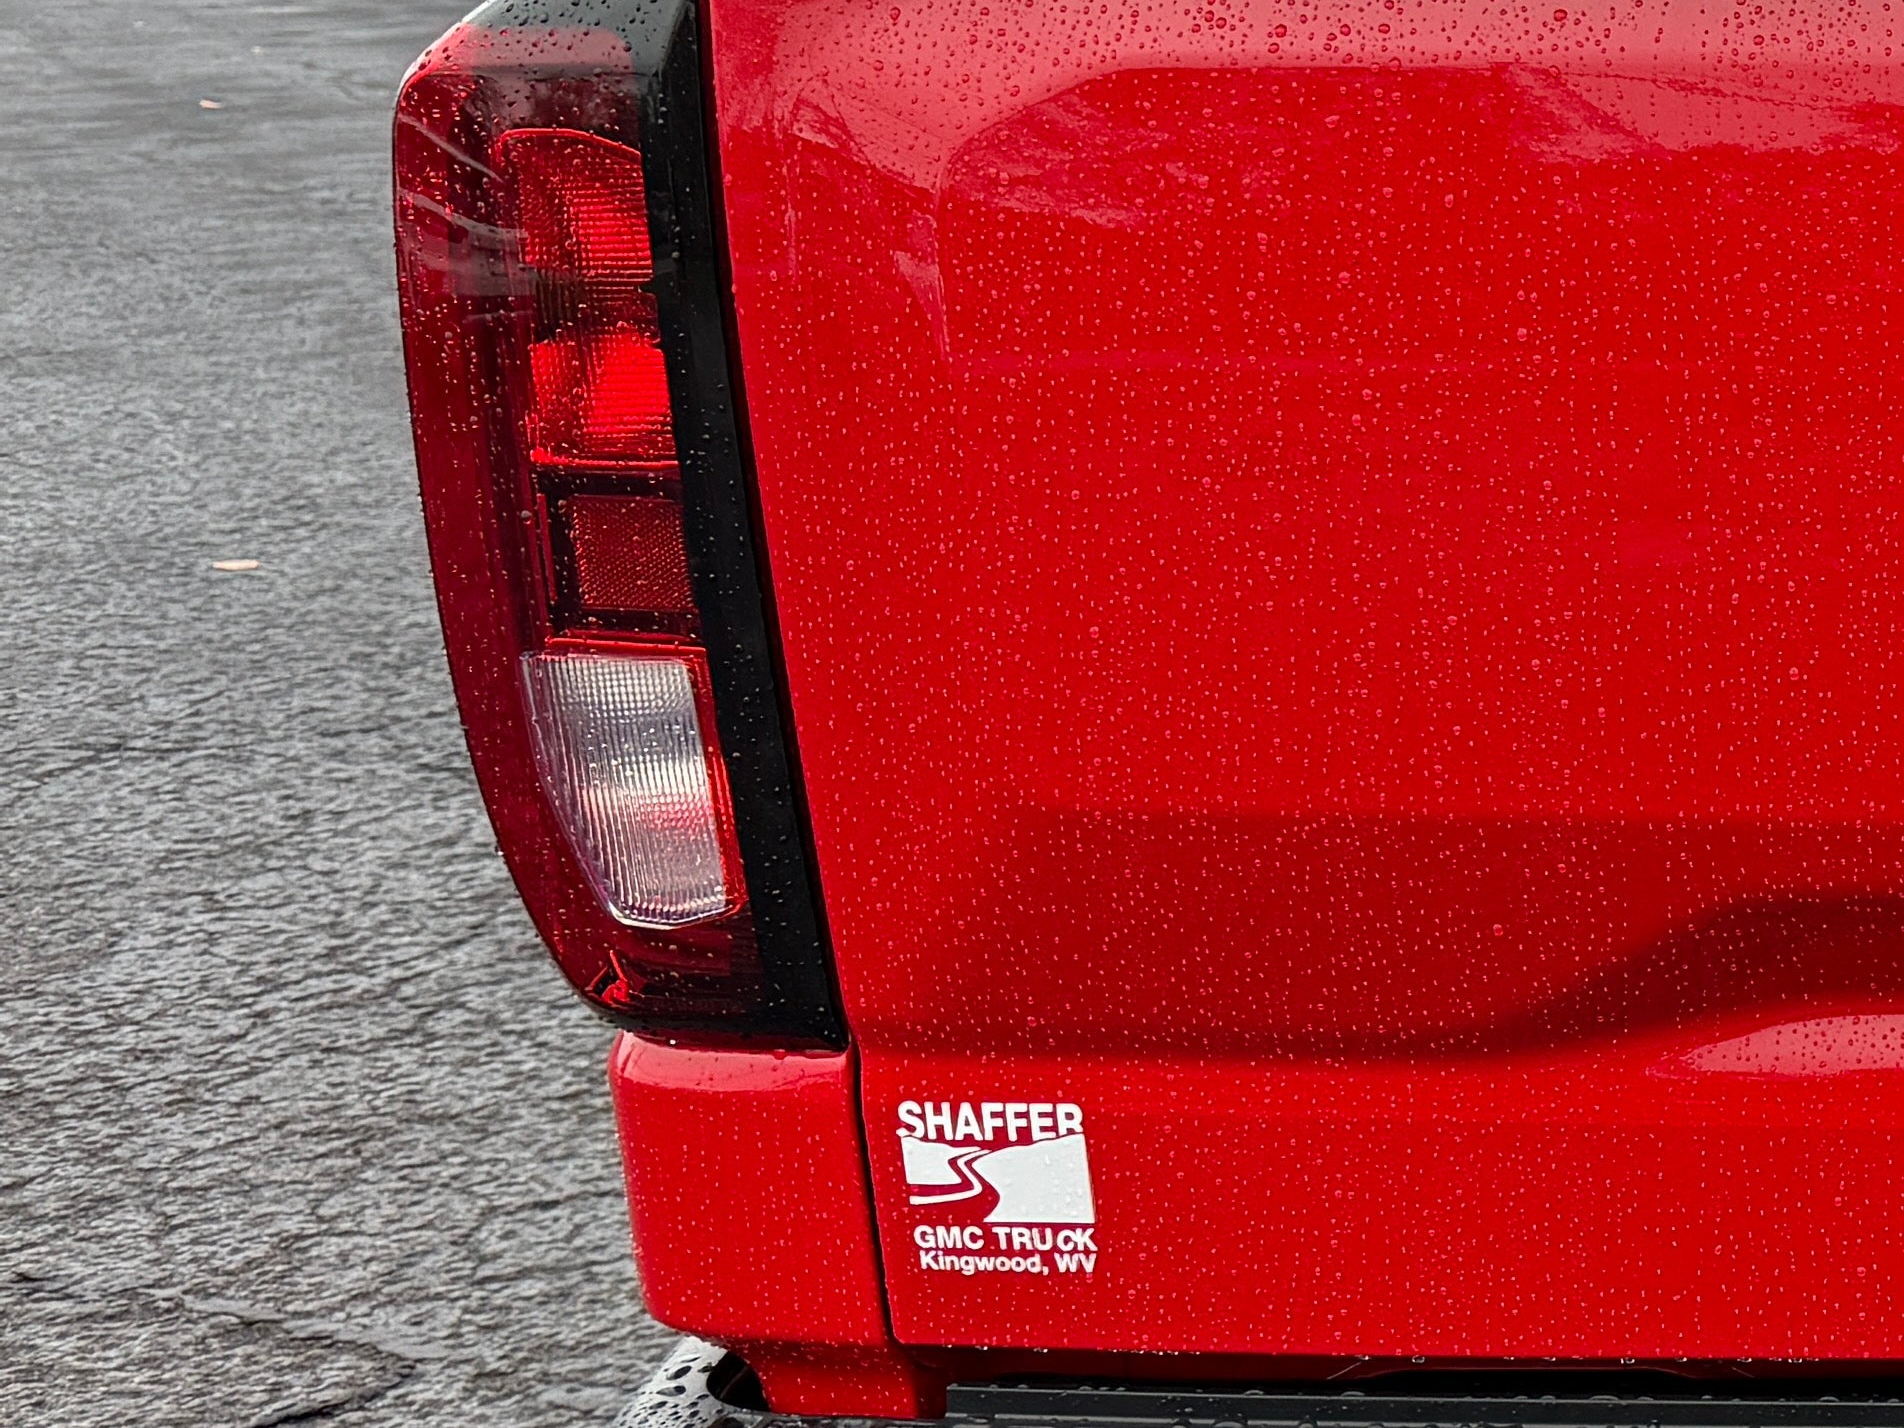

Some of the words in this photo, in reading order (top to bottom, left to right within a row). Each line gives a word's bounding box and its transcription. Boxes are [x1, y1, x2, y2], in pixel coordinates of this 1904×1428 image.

[896, 1100, 1084, 1142] SHAFFER
[913, 1224, 985, 1250] GMC
[992, 1226, 1098, 1252] TRUCK
[919, 1249, 1049, 1276] Kingwood,
[1053, 1252, 1097, 1273] WV
